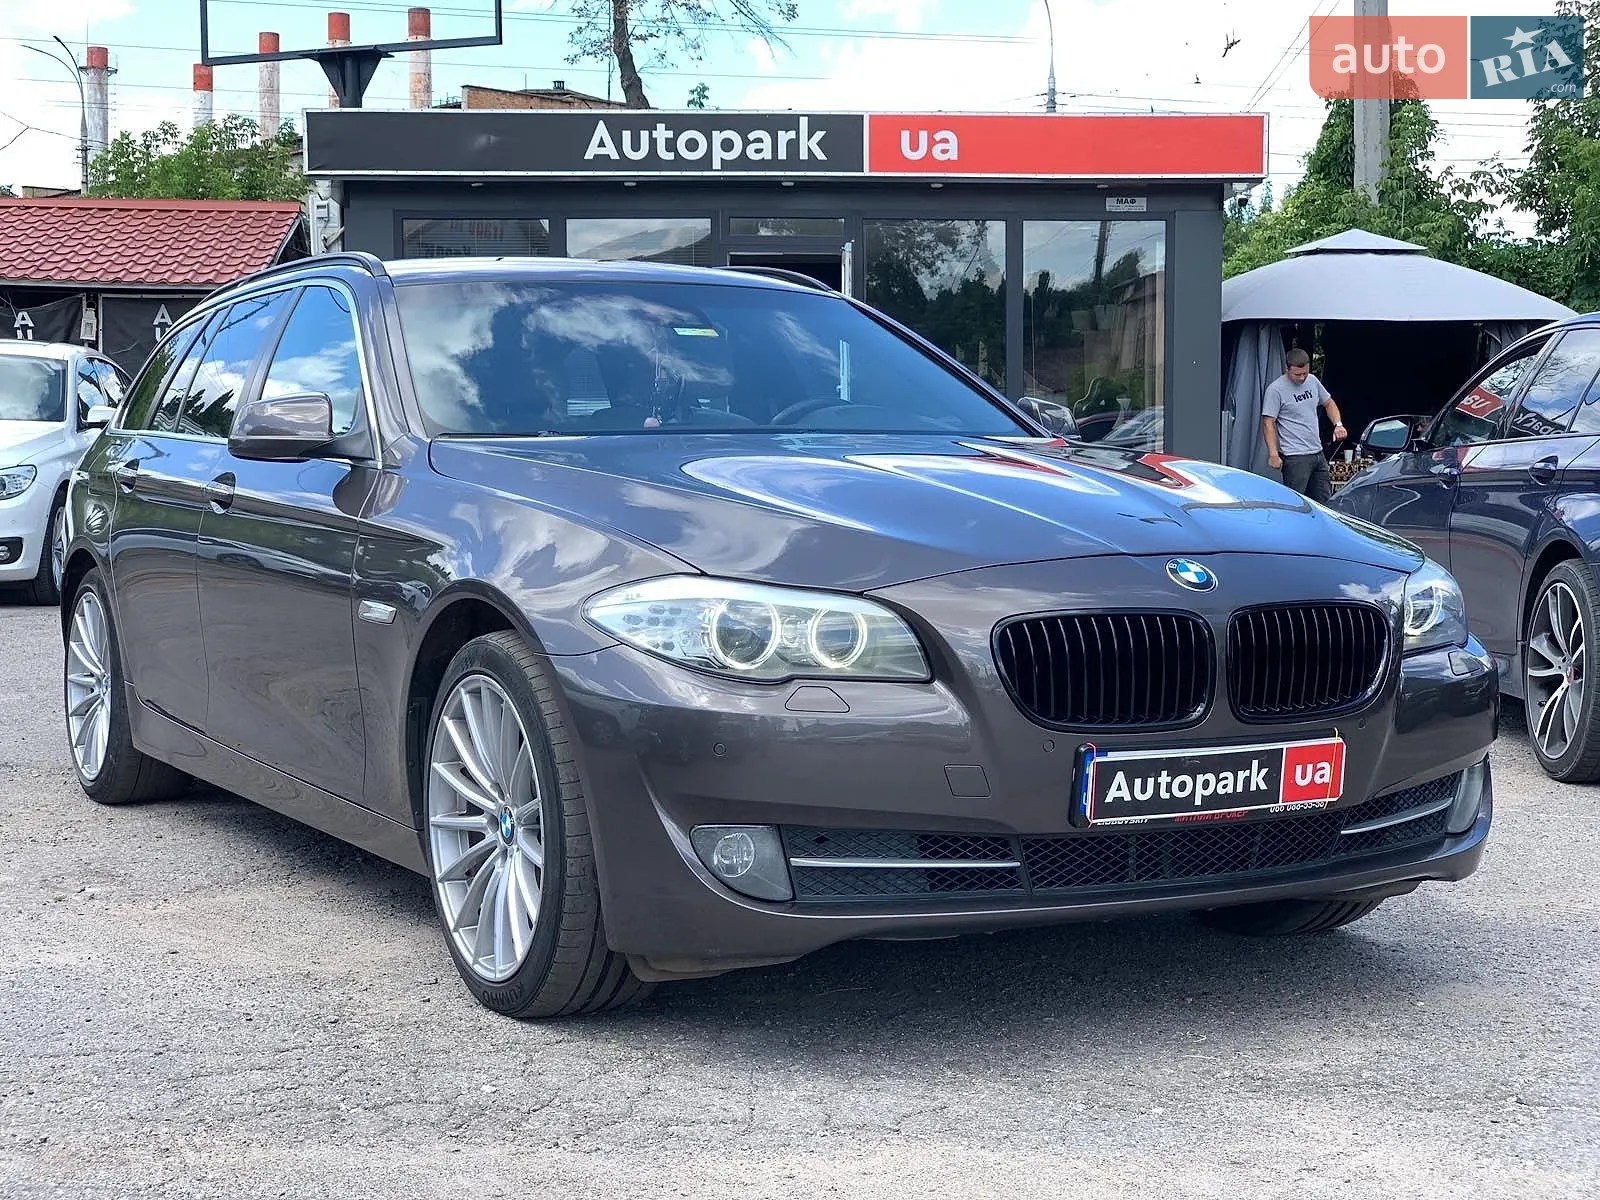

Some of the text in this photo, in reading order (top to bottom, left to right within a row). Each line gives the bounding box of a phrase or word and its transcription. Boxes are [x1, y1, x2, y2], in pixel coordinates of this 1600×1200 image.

[584, 116, 959, 169] Autopark ua
[153, 304, 173, 325] A
[1104, 759, 1269, 805] Autopark
[1295, 761, 1331, 785] ua
